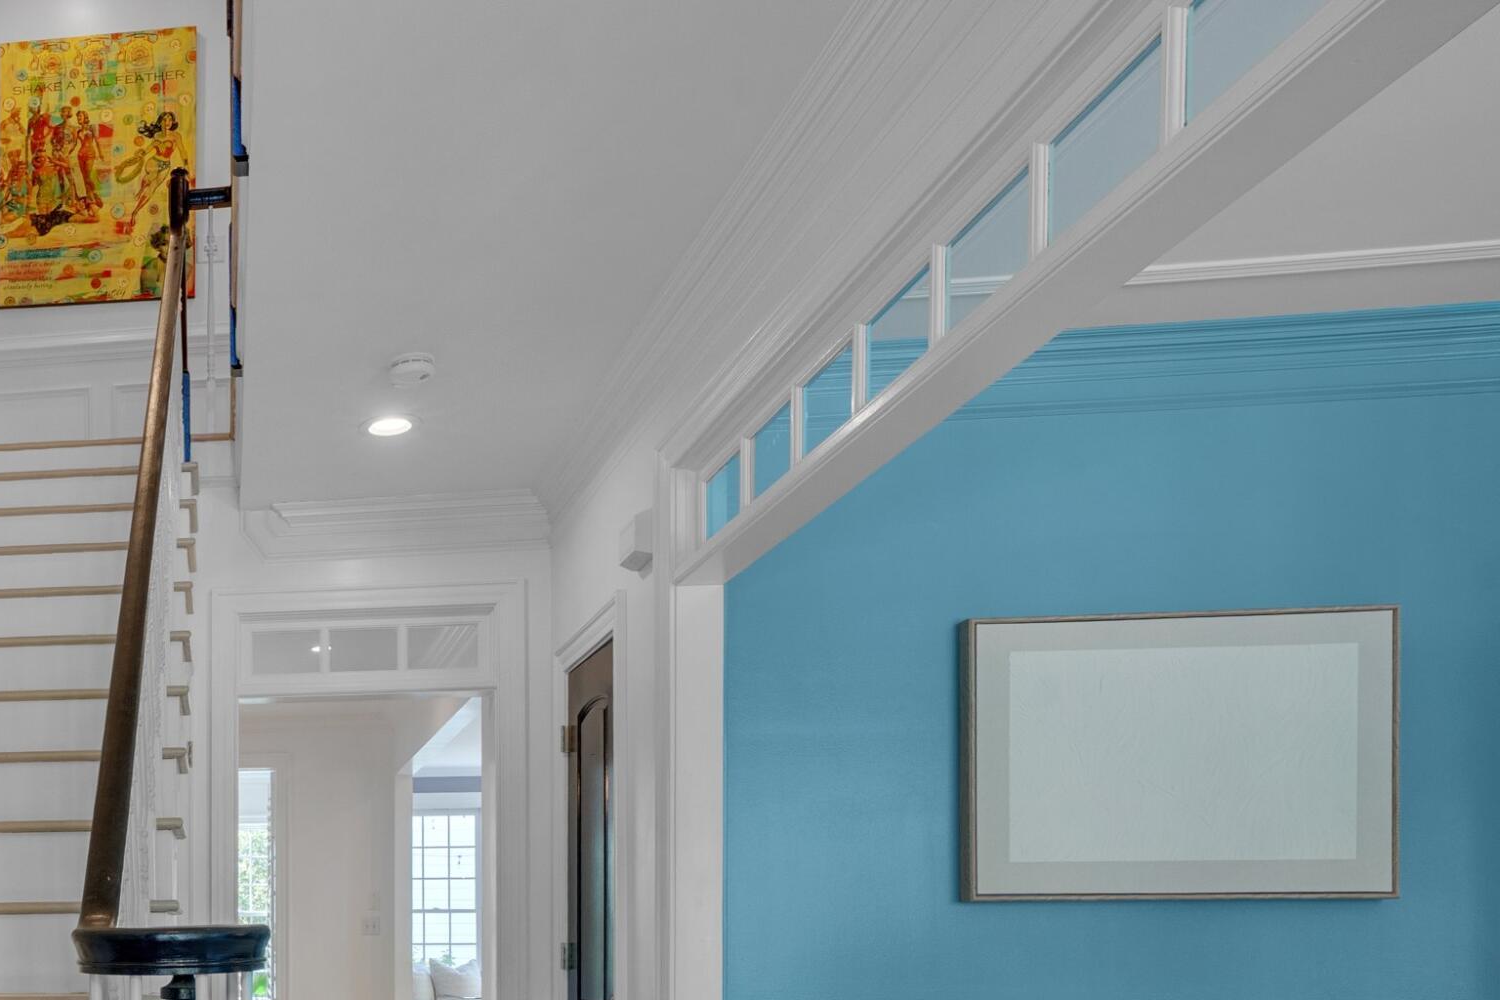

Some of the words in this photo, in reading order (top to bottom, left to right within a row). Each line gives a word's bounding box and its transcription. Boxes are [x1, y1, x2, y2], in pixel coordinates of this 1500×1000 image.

[12, 81, 62, 96] SHAKE
[66, 81, 77, 90] A
[80, 78, 111, 89] TAIL
[115, 69, 187, 85] FEATHER
